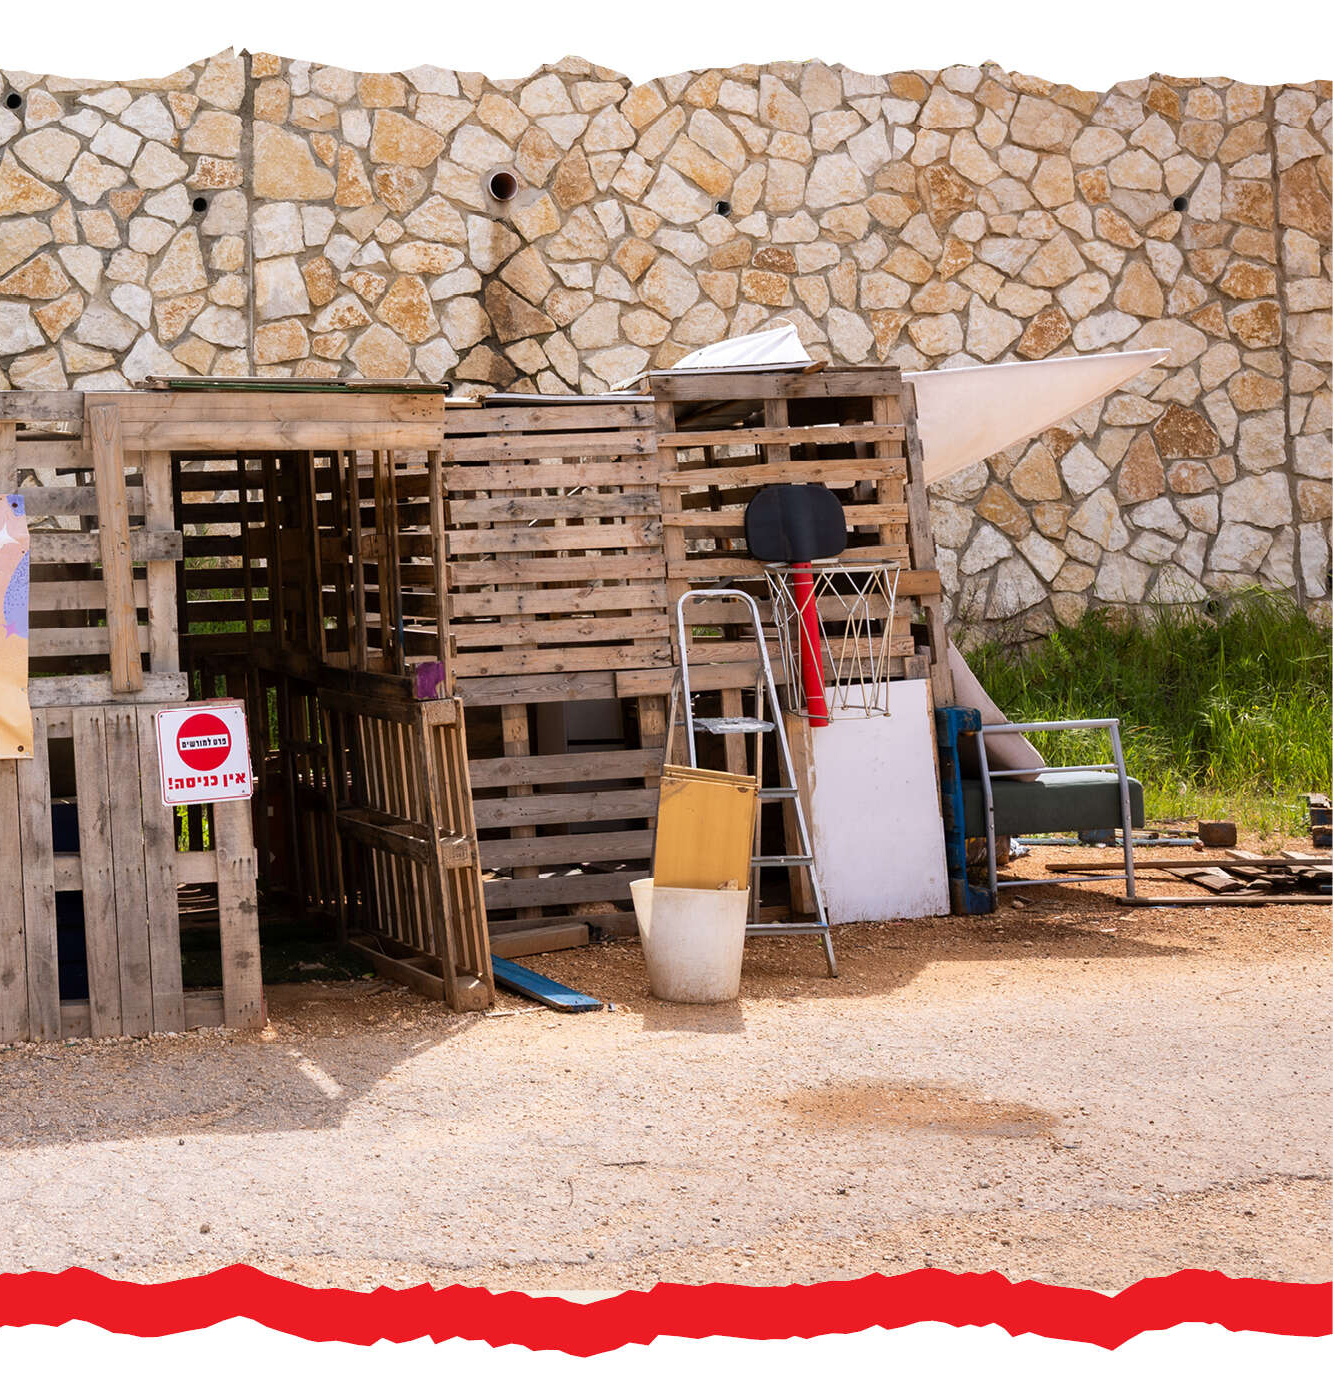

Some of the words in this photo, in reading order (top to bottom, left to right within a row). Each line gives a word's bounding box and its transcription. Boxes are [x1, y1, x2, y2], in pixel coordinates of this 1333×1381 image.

[181, 737, 212, 748] למורשים
[213, 737, 227, 746] פרט
[168, 775, 219, 790] כניסה!
[223, 772, 246, 787] אין
